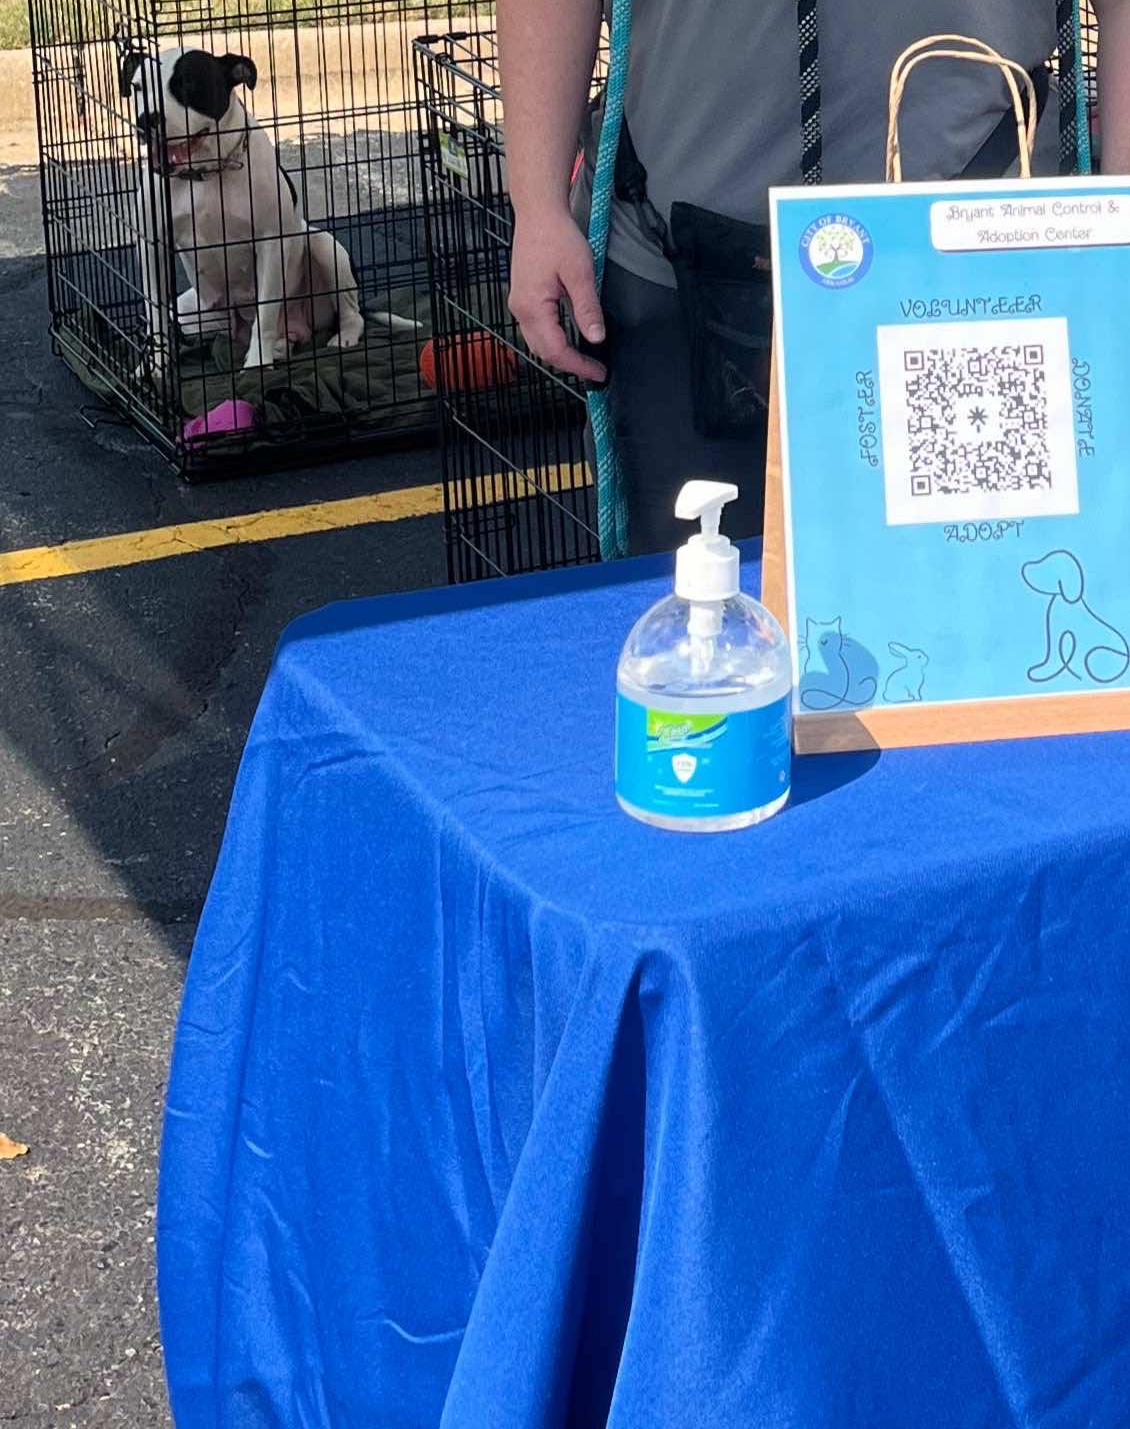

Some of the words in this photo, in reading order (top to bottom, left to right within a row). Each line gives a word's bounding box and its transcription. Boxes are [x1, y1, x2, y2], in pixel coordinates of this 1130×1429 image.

[947, 204, 994, 223] Bryant
[1000, 202, 1046, 217] Animal
[1051, 200, 1102, 217] Control
[1107, 200, 1120, 214] &
[977, 228, 1040, 244] Adoption
[1044, 227, 1093, 242] Center
[900, 294, 1043, 318] VOLUNTEER
[856, 370, 878, 467] FOSTER
[1072, 357, 1096, 458] DONATE
[943, 520, 1025, 543] ADOPT
